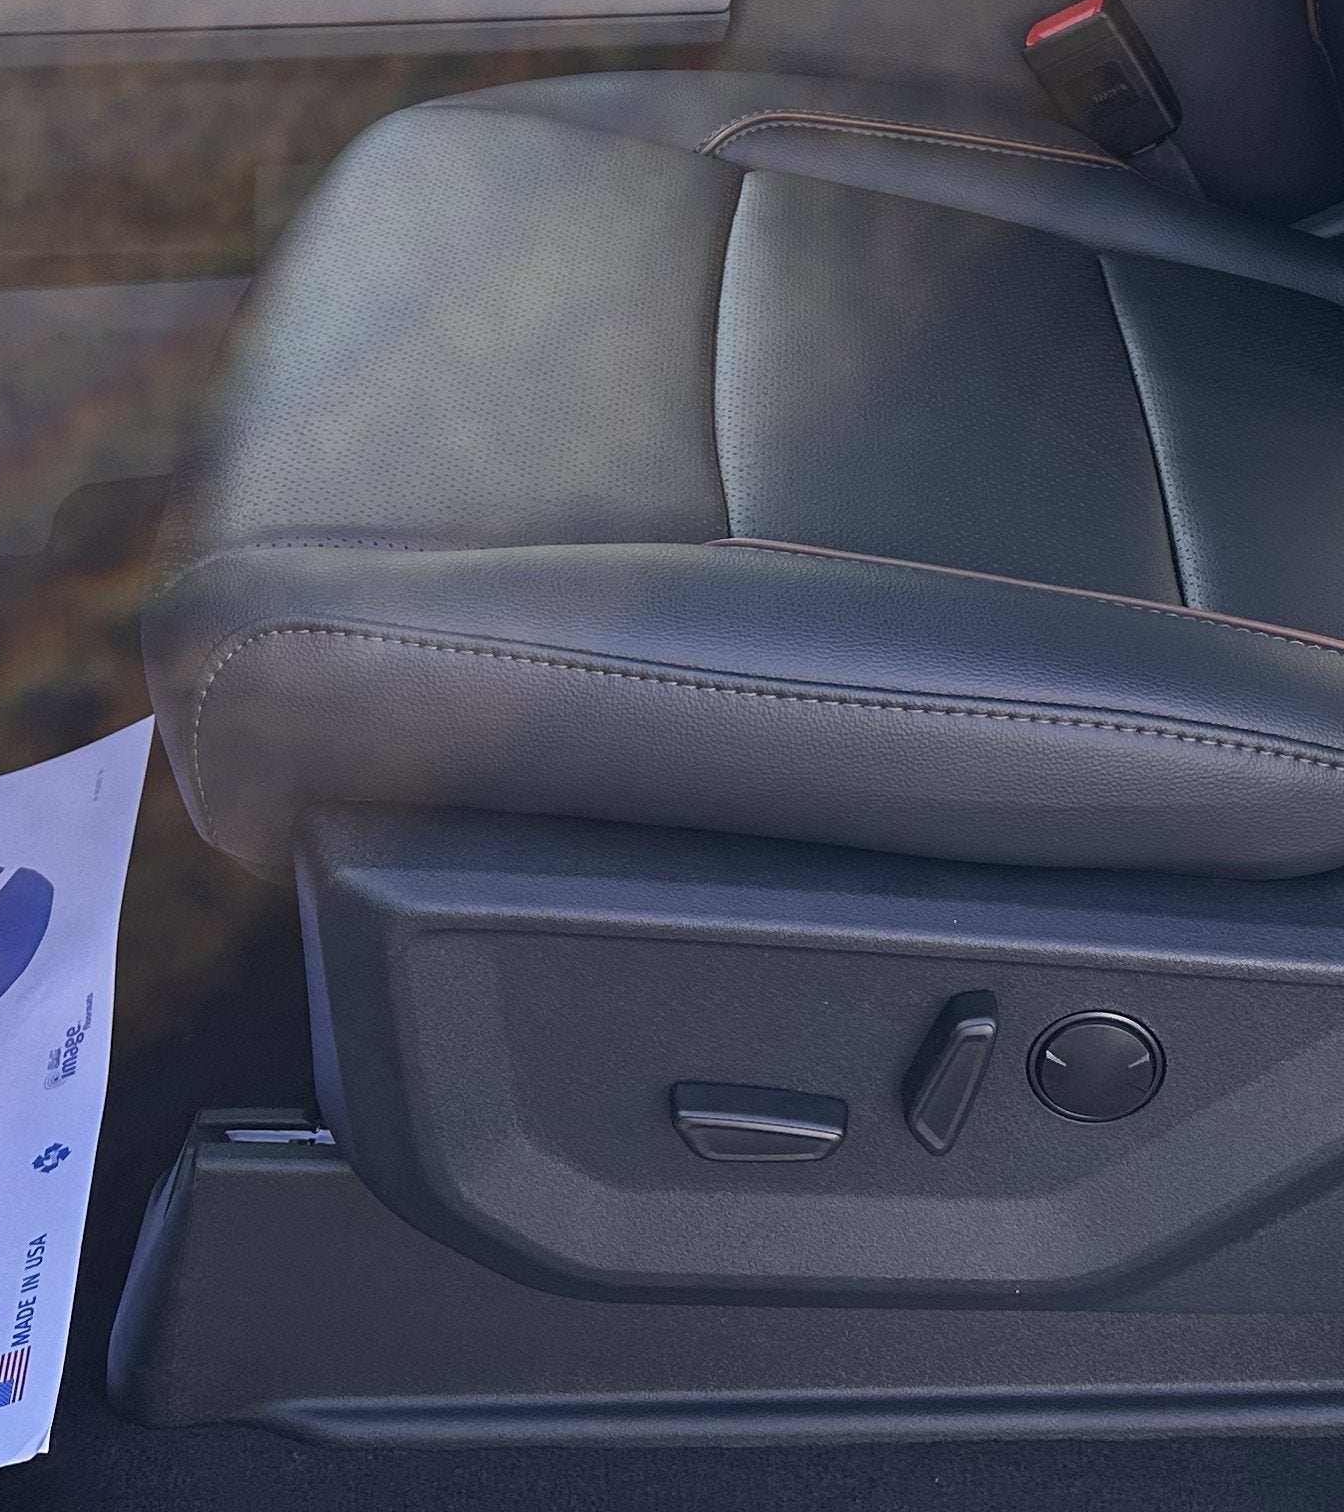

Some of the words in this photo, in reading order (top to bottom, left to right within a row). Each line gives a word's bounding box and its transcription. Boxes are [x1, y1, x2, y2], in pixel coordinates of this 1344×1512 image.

[61, 1025, 84, 1079] image
[25, 1233, 47, 1270] USA
[21, 1272, 41, 1293] IN
[11, 1295, 36, 1347] MADE
